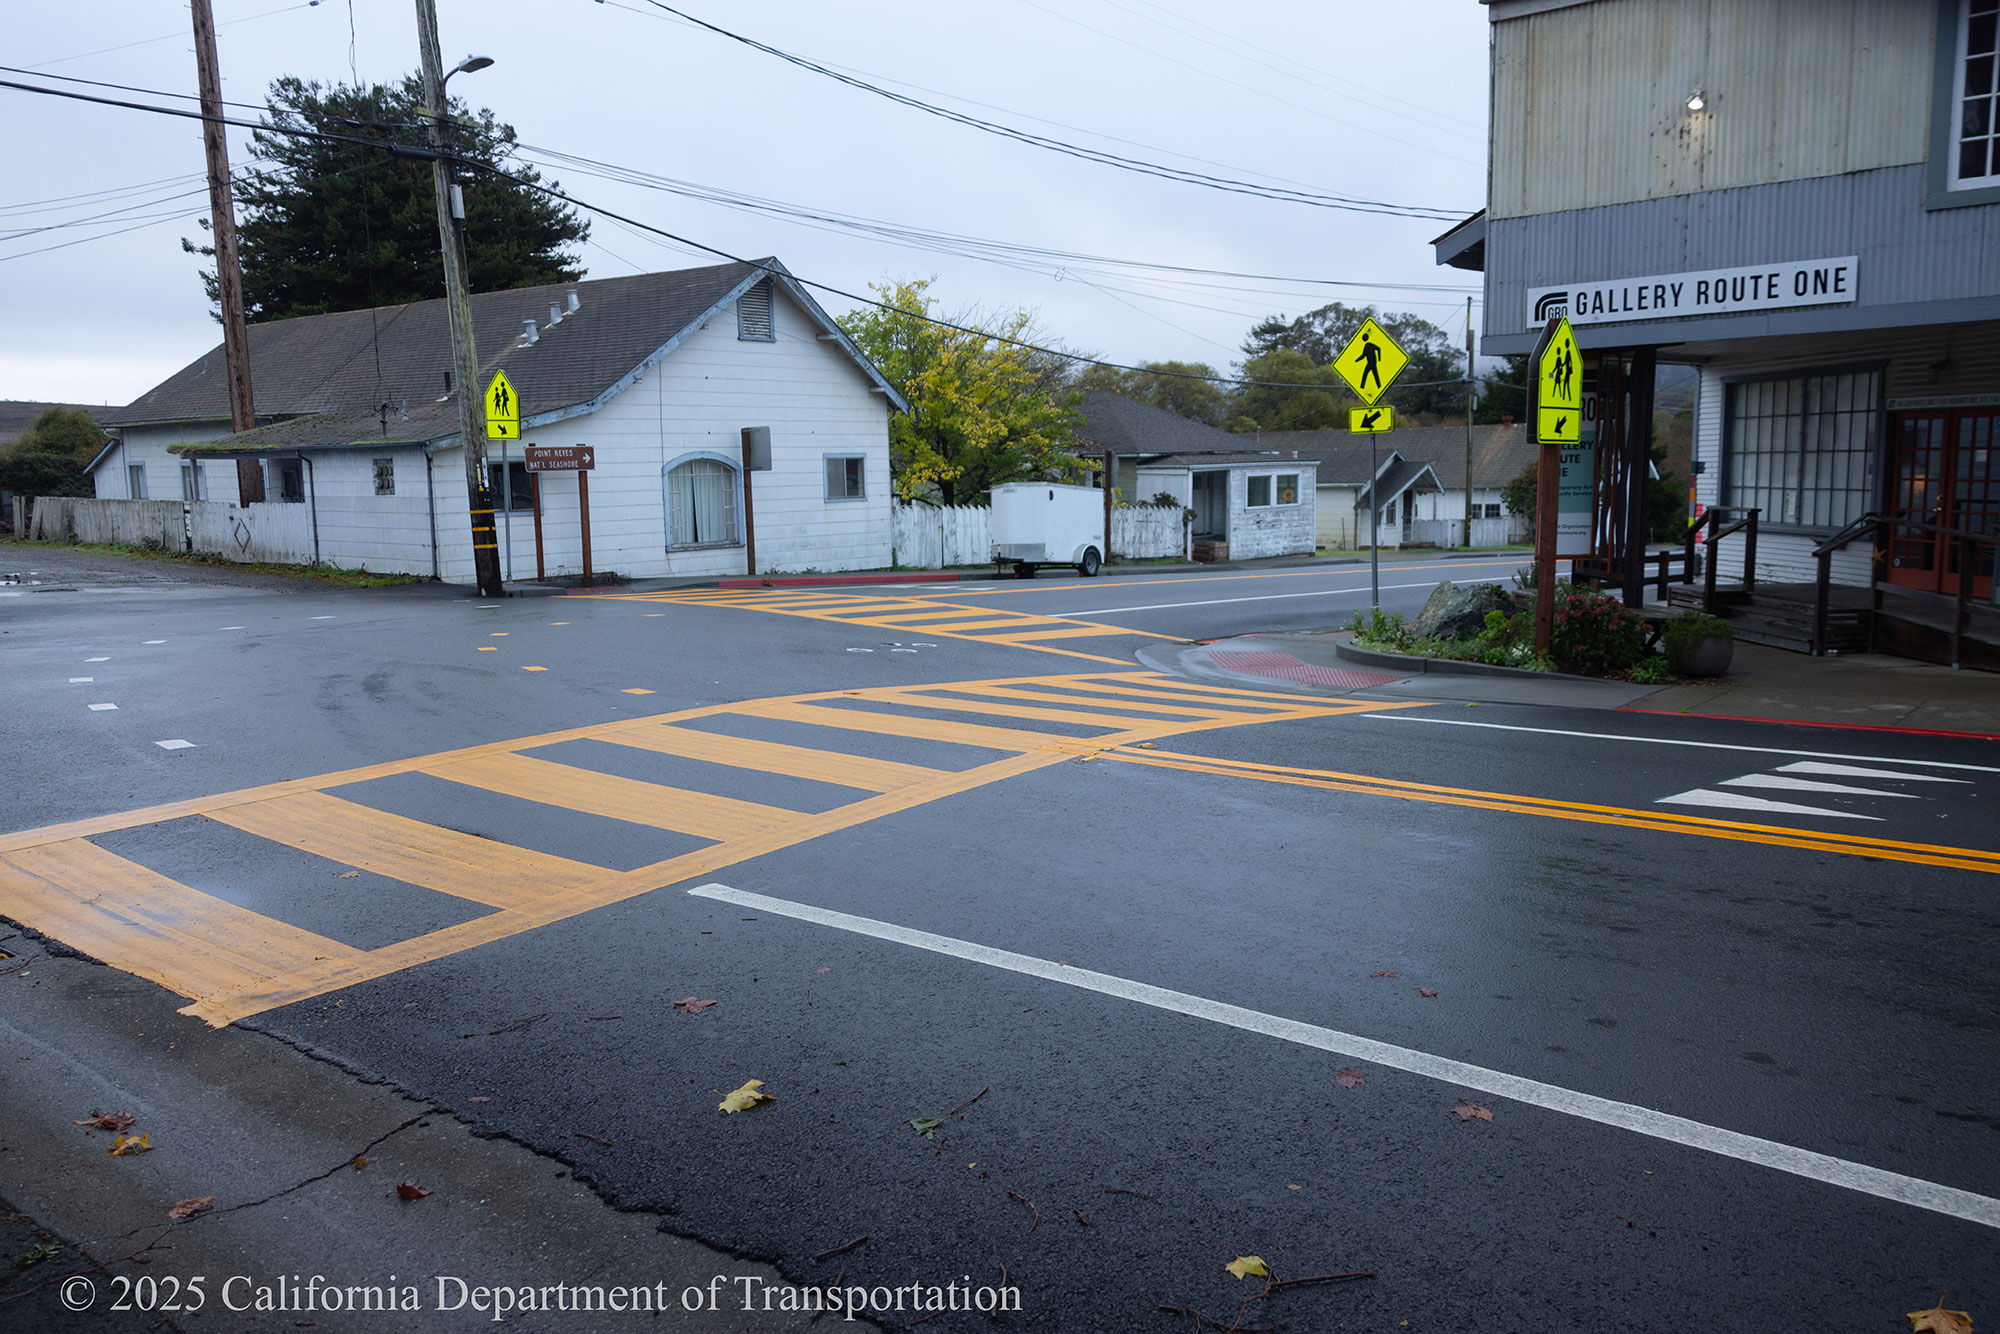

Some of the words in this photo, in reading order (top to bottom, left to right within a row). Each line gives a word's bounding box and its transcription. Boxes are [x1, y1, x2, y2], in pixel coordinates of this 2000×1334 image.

[1575, 281, 1684, 316] GALLERY
[1696, 272, 1781, 306] ROUTE
[1793, 266, 1848, 297] ONE
[1547, 305, 1568, 319] GRO
[1561, 440, 1594, 450] LLERY
[534, 449, 551, 458] POINT
[554, 449, 573, 457] REYES
[1560, 454, 1581, 463] UTE
[549, 460, 579, 468] SEASHORE
